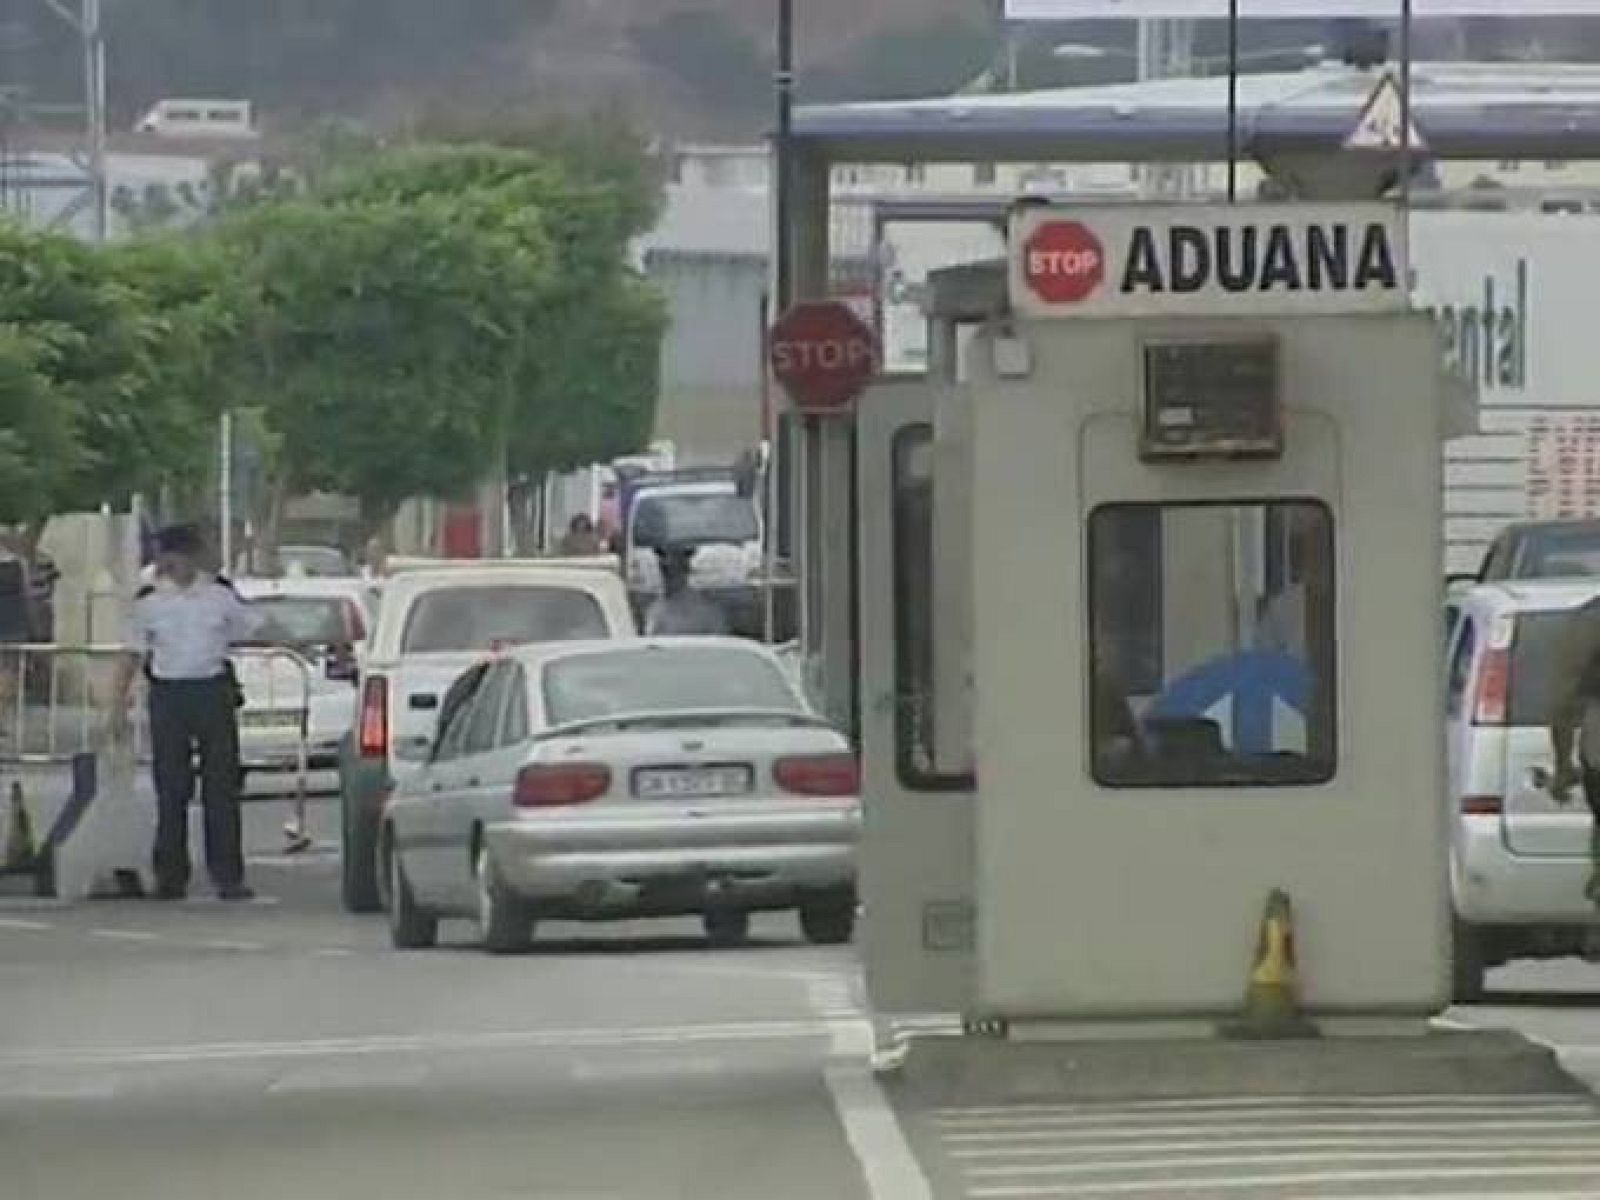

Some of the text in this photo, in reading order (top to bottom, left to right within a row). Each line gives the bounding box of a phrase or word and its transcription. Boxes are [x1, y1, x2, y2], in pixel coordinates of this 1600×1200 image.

[1029, 223, 1398, 294] STOP ADUANA
[773, 339, 871, 370] STOP
